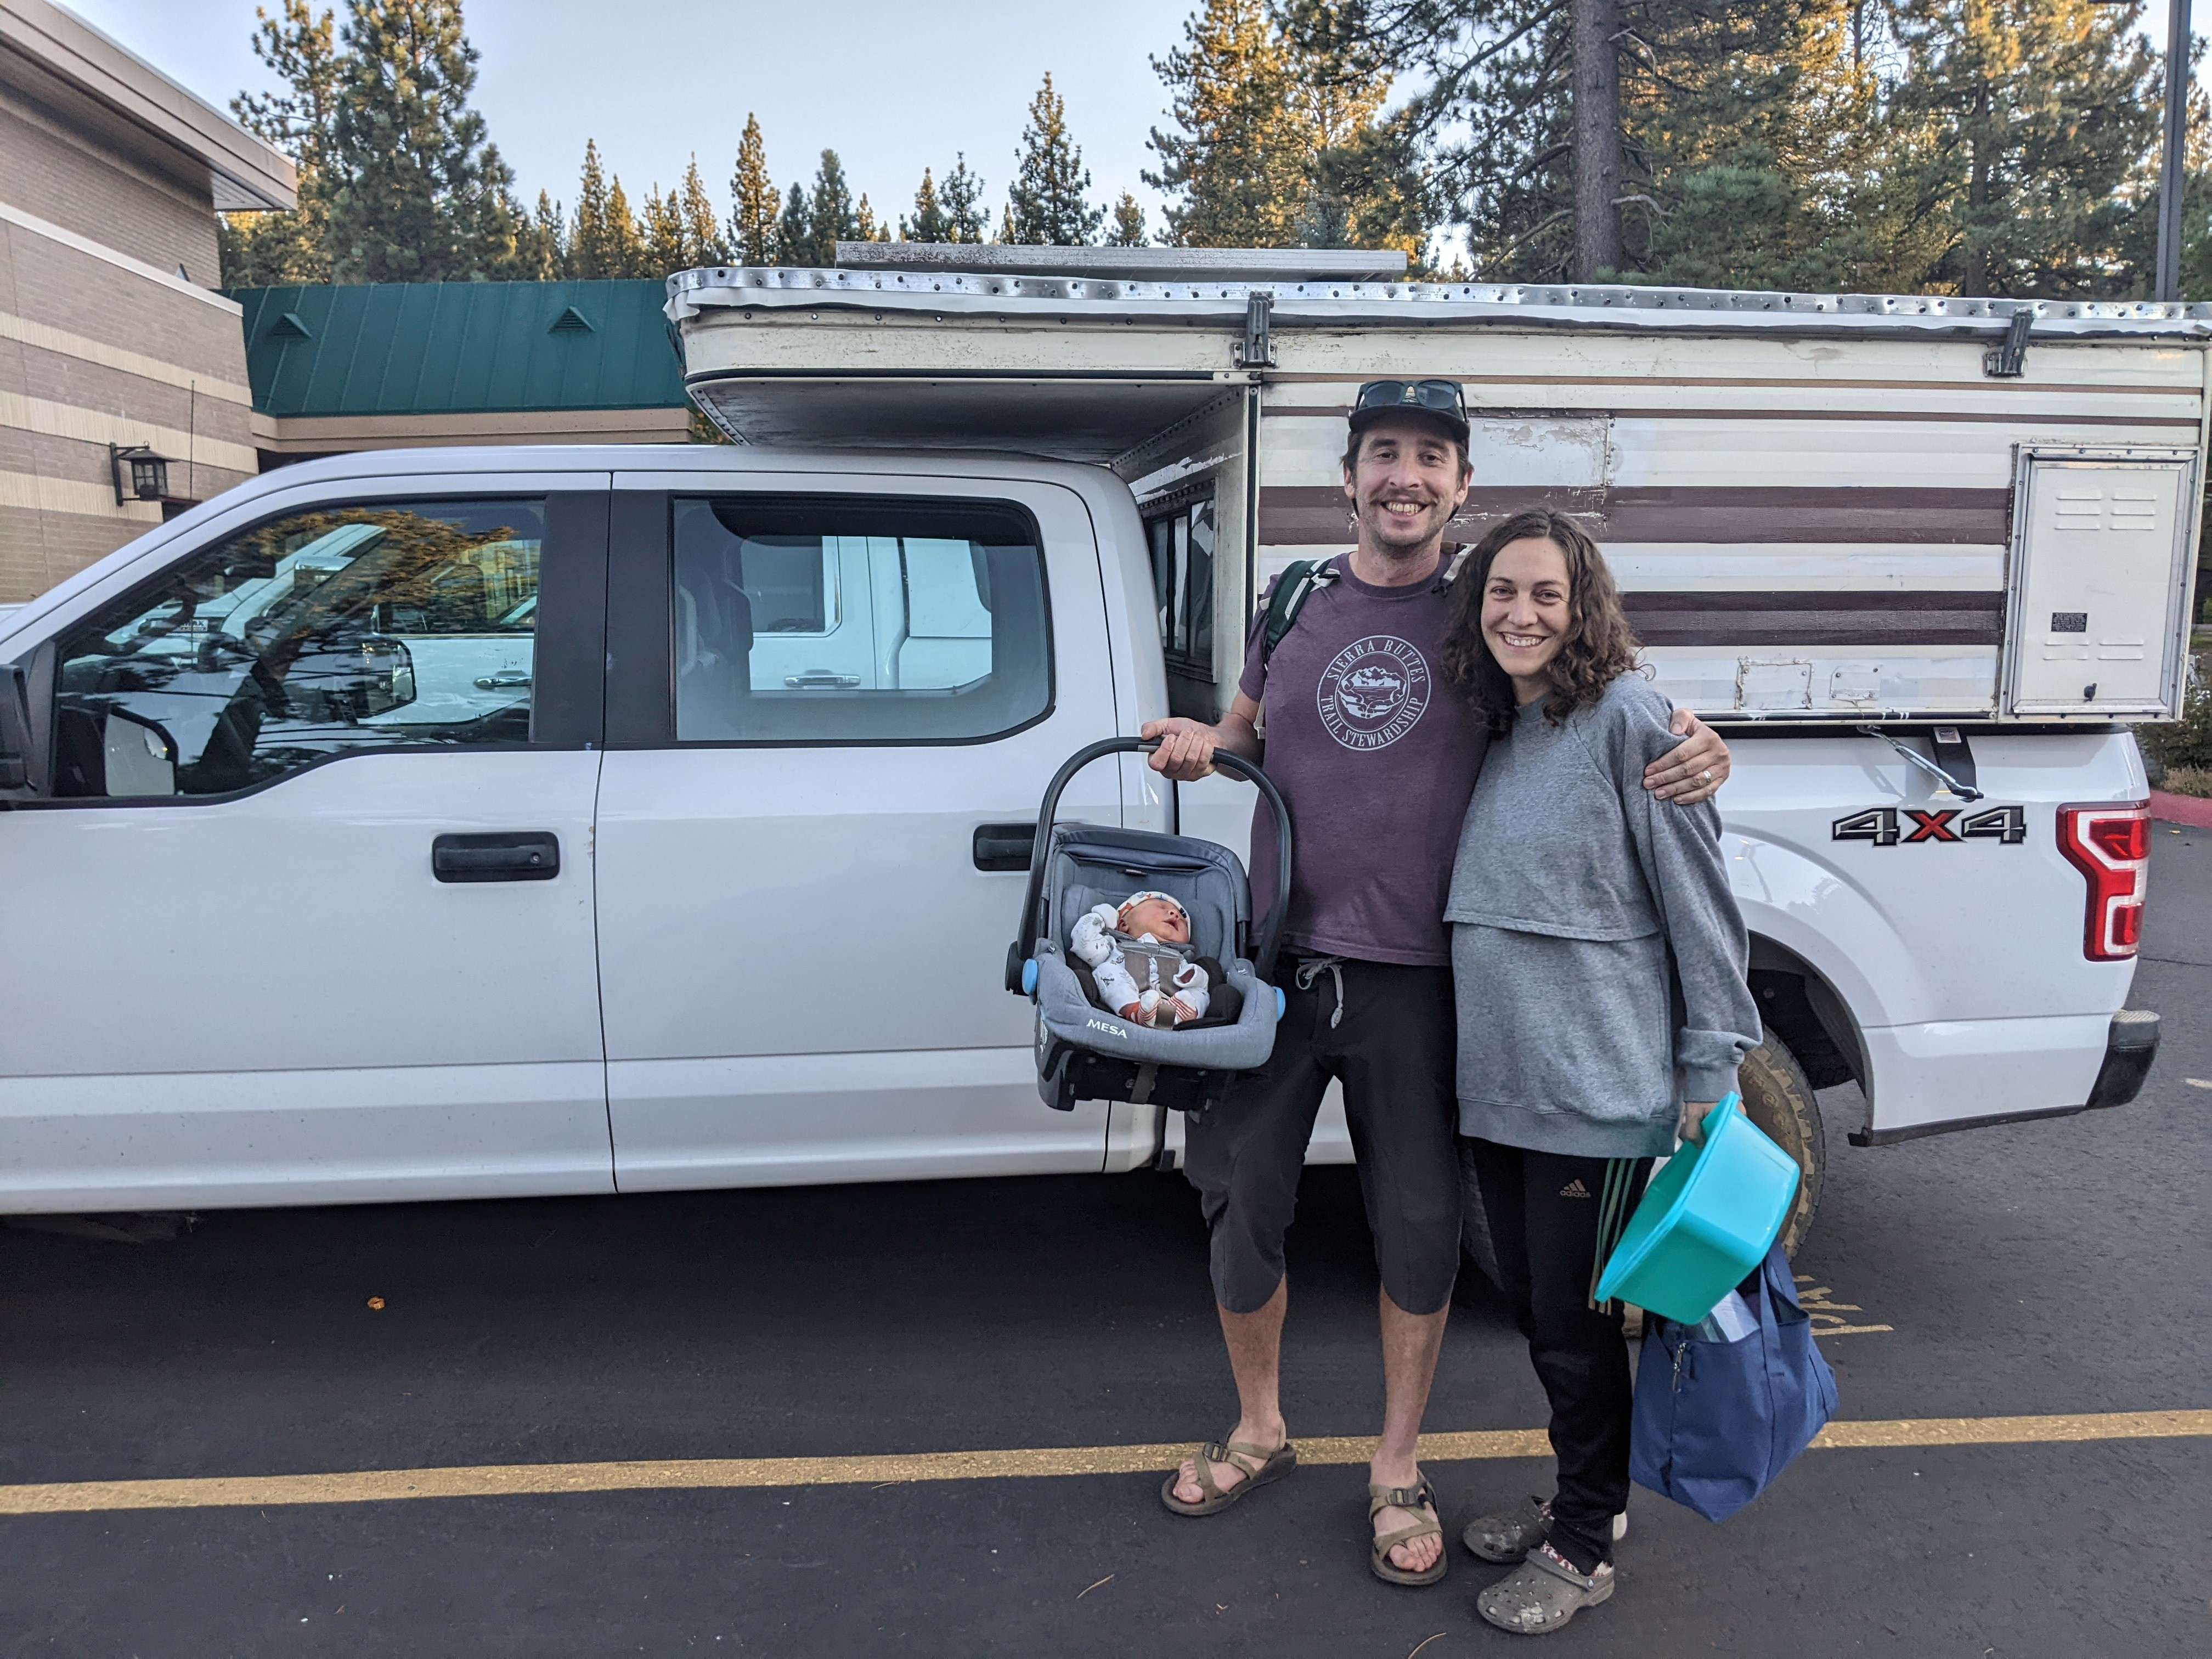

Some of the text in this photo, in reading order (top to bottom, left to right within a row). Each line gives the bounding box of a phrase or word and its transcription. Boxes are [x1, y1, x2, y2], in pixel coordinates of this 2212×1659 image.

[1327, 639, 1425, 683] SIERRA BUTTES
[1321, 695, 1424, 747] TRAIL STEWARDSHIP
[1086, 1018, 1127, 1039] MESA
